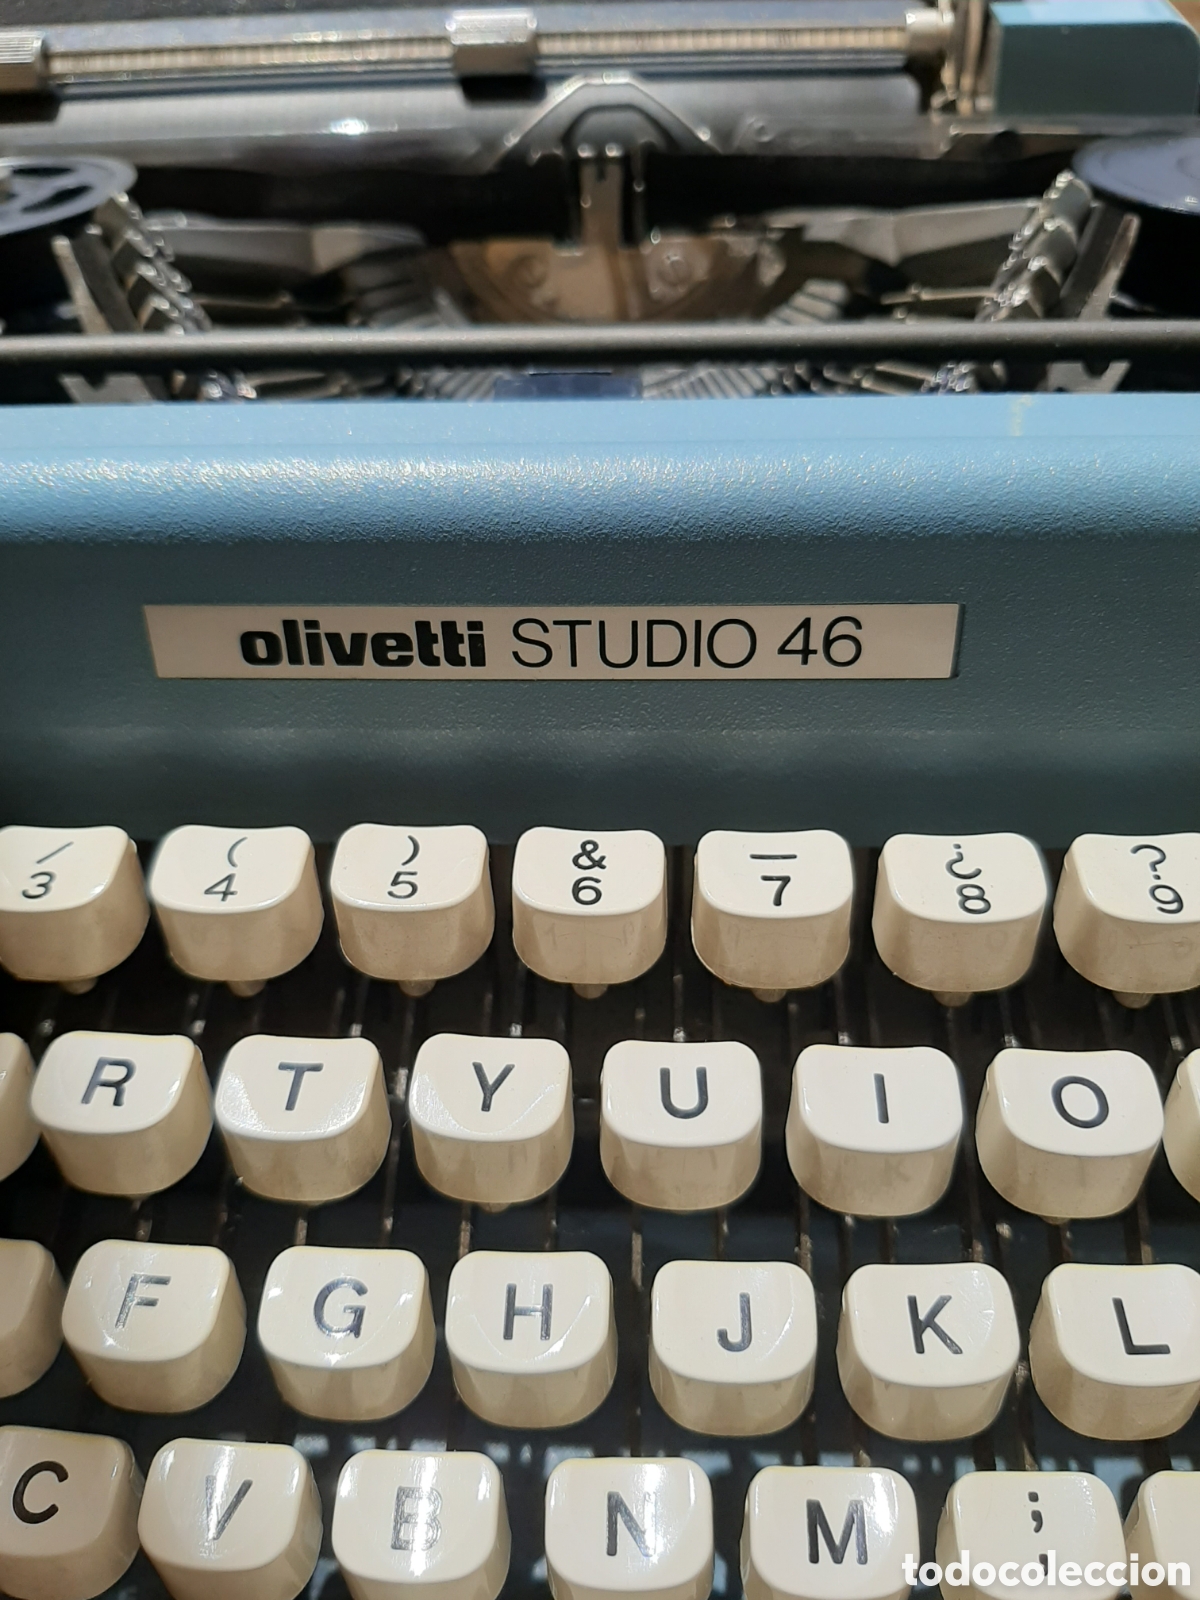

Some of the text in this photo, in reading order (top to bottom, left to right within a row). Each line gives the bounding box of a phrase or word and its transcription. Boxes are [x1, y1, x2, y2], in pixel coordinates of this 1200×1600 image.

[240, 616, 864, 668] olivetti STUDIO 46
[226, 836, 247, 868] (
[401, 835, 420, 866] )
[571, 839, 607, 870] &
[1131, 844, 1167, 881] ?
[22, 871, 56, 900] 3
[203, 873, 238, 902] 4
[387, 871, 418, 899] 5
[571, 876, 602, 905] 6
[760, 875, 791, 907] 7
[957, 883, 991, 915] 8
[1149, 884, 1184, 915] 9
[81, 1057, 137, 1107] R
[278, 1062, 323, 1111] T
[472, 1061, 515, 1112] Y
[660, 1067, 709, 1119] U
[874, 1073, 889, 1124] I
[1051, 1075, 1109, 1128] O
[115, 1273, 171, 1329] F
[313, 1276, 368, 1339] G
[503, 1283, 554, 1341] H
[717, 1292, 753, 1352] J
[907, 1295, 963, 1355] K
[1112, 1297, 1171, 1355] L
[12, 1460, 69, 1525] C
[204, 1475, 253, 1543] V
[390, 1486, 443, 1551] B
[606, 1491, 657, 1558] N
[806, 1499, 868, 1565] M
